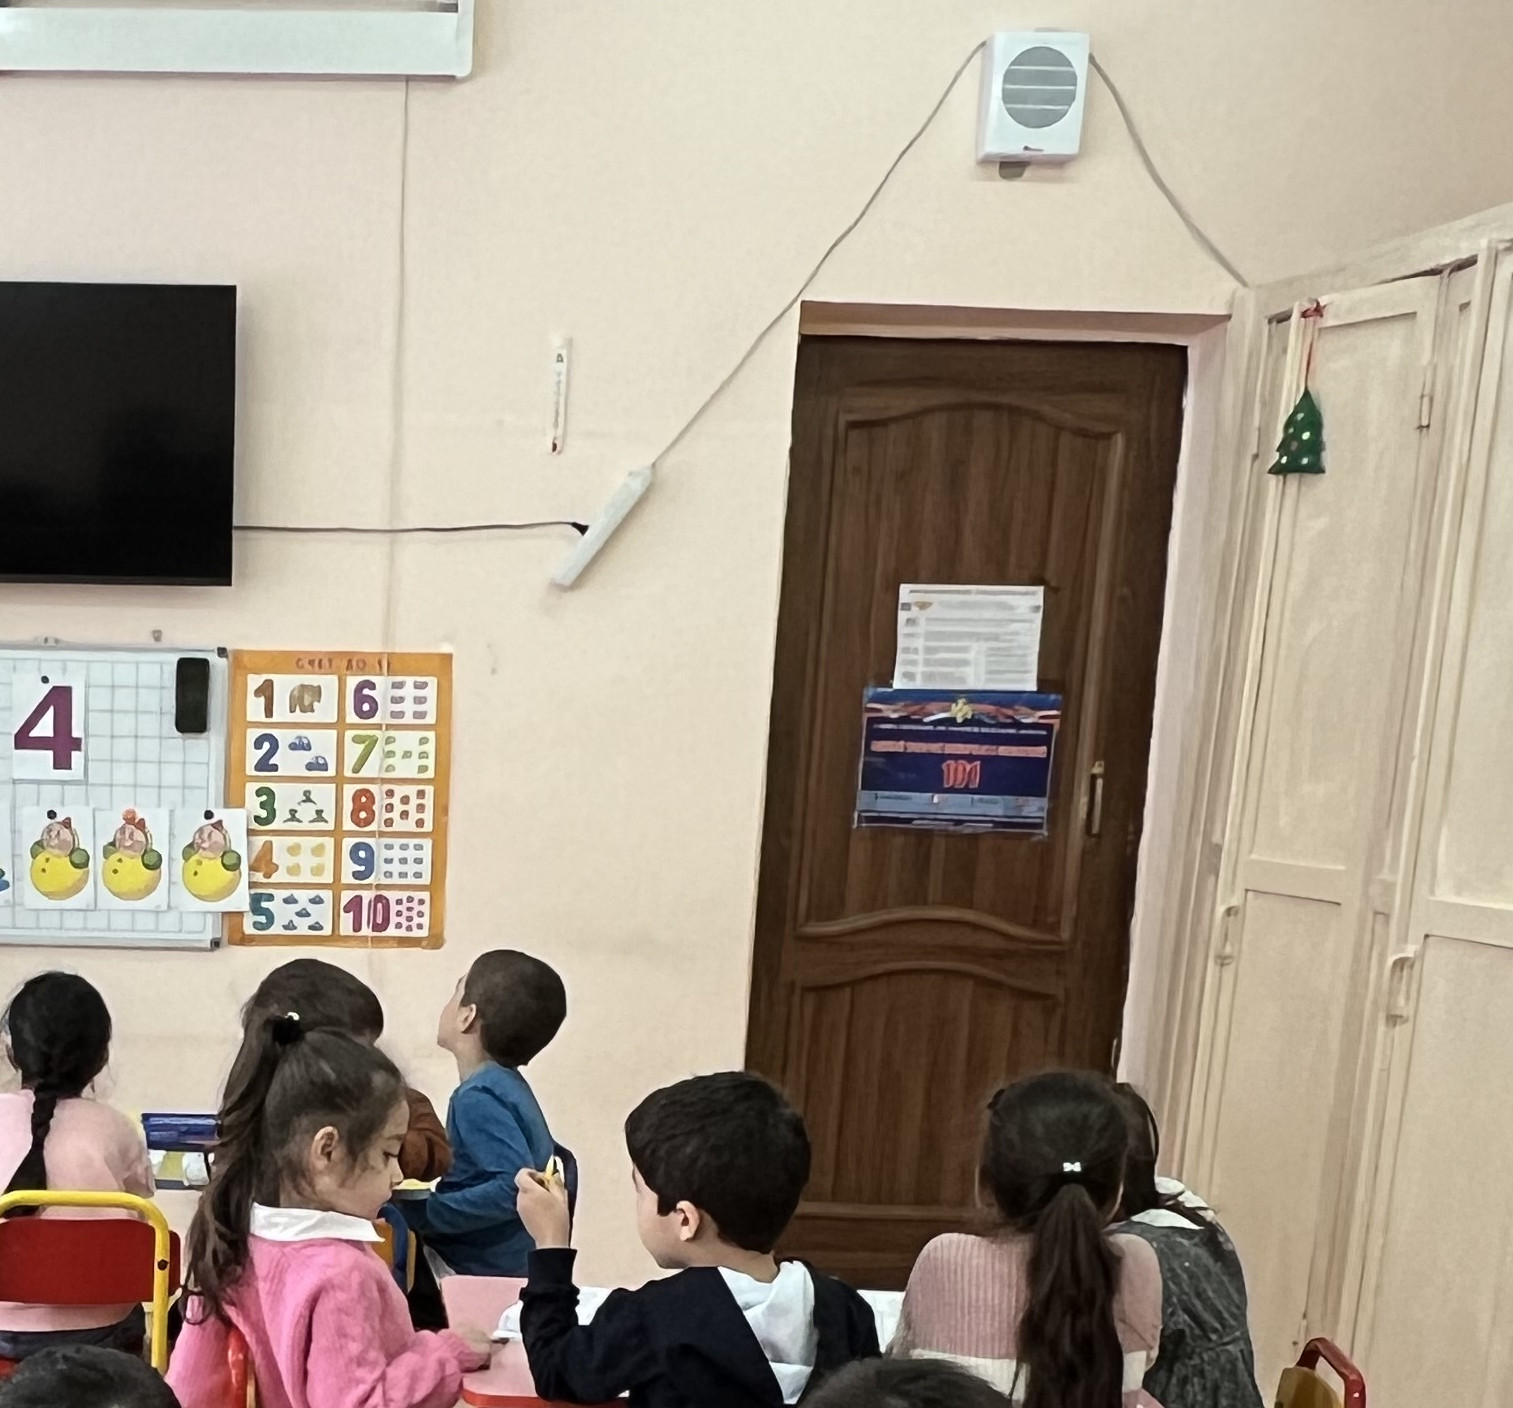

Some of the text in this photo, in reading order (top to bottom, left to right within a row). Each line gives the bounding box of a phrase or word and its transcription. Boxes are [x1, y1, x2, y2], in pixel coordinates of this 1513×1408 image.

[254, 679, 274, 718] 1
[354, 679, 379, 720] 6
[14, 685, 82, 770] 4
[254, 733, 279, 772] 2
[352, 734, 379, 774] 7
[254, 786, 276, 826] 3
[350, 788, 376, 828] 8
[249, 840, 279, 879] 4
[349, 841, 375, 881] 9
[249, 892, 275, 931] 5
[343, 894, 391, 933] 10
